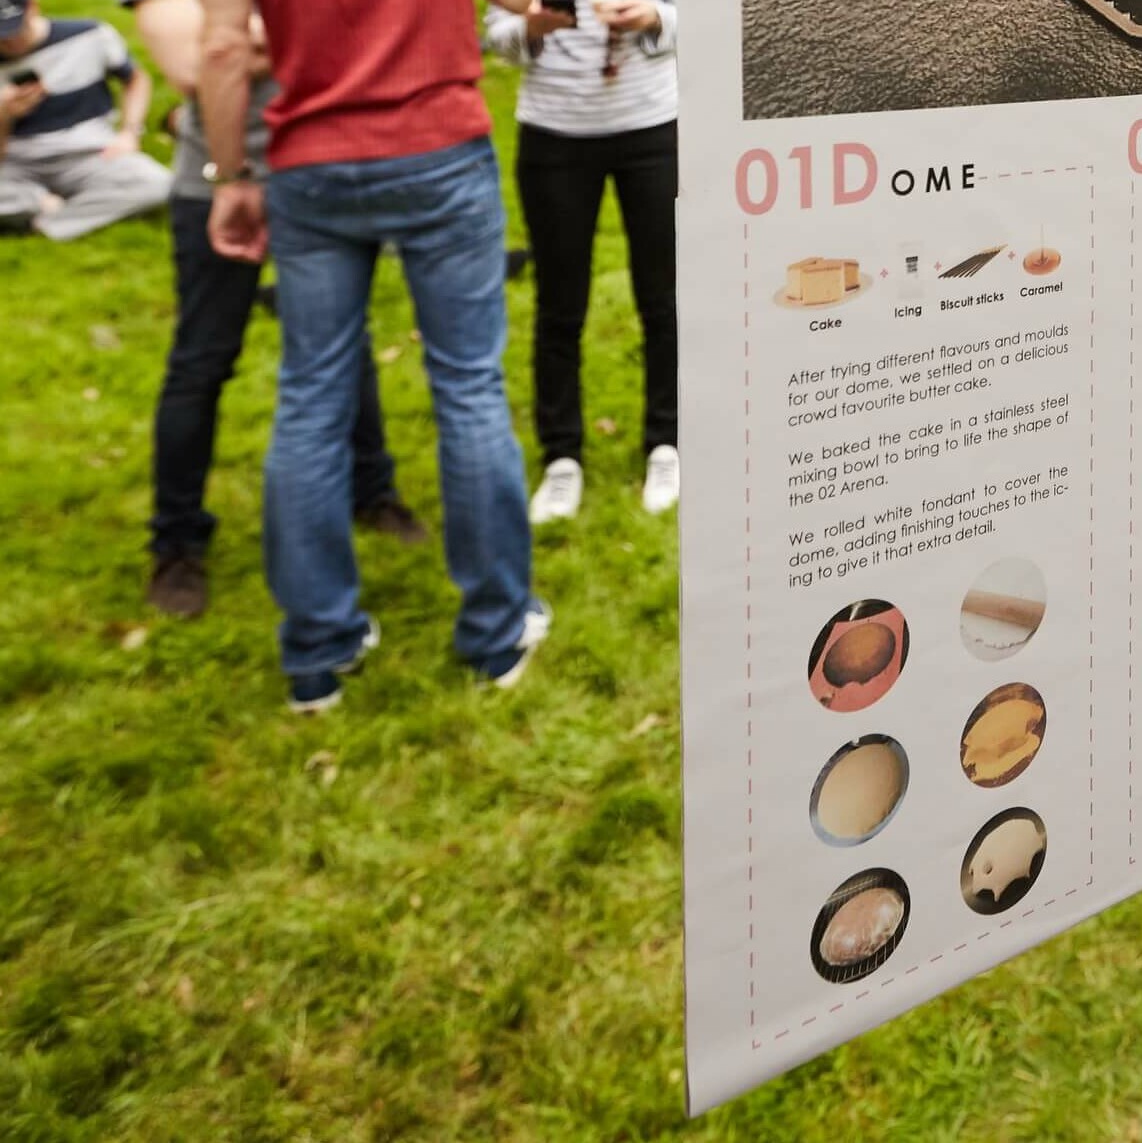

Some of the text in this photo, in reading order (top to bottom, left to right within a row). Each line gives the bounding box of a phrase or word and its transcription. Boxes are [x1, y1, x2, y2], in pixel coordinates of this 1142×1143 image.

[940, 292, 1004, 310] Biscuit sticks
[1020, 282, 1062, 297] Caramel
[810, 318, 842, 331] Cake
[895, 306, 922, 318] Icing
[788, 323, 1068, 387] After trying different flavours and moulds
[788, 393, 808, 407] for
[815, 387, 839, 401] our
[899, 372, 920, 384] we
[927, 359, 972, 380] settled
[978, 358, 995, 369] on
[1000, 355, 1009, 365] a
[1015, 343, 1069, 362] delicious
[788, 377, 991, 427] crowd favourite butter cake.
[788, 393, 1068, 466] We baked the cake in a stainless steel
[789, 410, 1069, 488] mixing bowl to bring to life the shape of
[789, 492, 814, 507] the
[840, 475, 888, 495] Arena.
